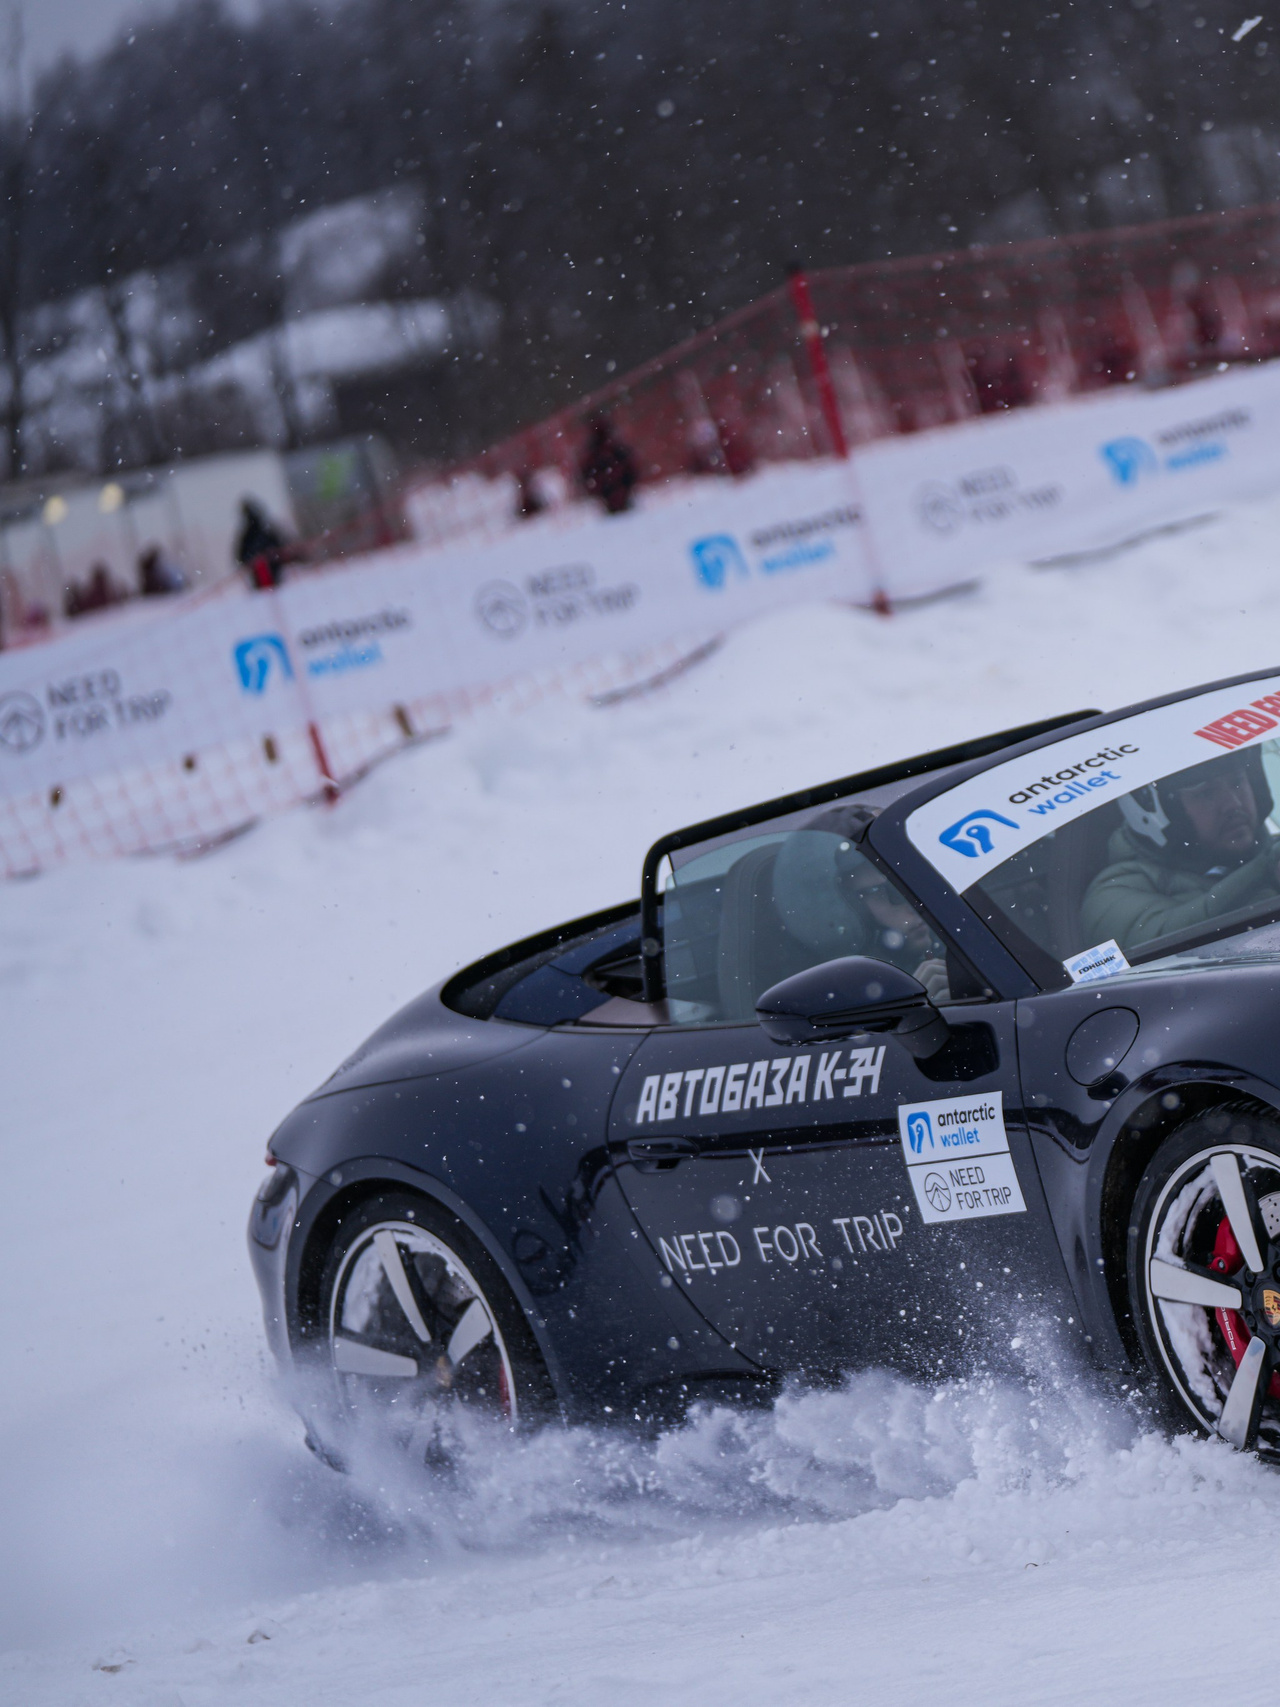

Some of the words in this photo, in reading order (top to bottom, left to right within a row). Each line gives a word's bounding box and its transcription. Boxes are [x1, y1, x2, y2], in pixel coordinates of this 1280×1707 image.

[1193, 709, 1278, 750] NEED
[1008, 744, 1140, 804] antarctic
[1027, 770, 1122, 815] wallet
[636, 1054, 812, 1125] АВТОБАЗА
[937, 1102, 996, 1127] antarctic
[940, 1126, 981, 1148] wallet
[948, 1166, 986, 1188] NEED
[955, 1190, 985, 1210] FOR
[982, 1186, 1012, 1207] TRIP
[659, 1230, 742, 1271] NEED
[753, 1222, 824, 1263] FOR
[832, 1212, 904, 1253] TRIP
